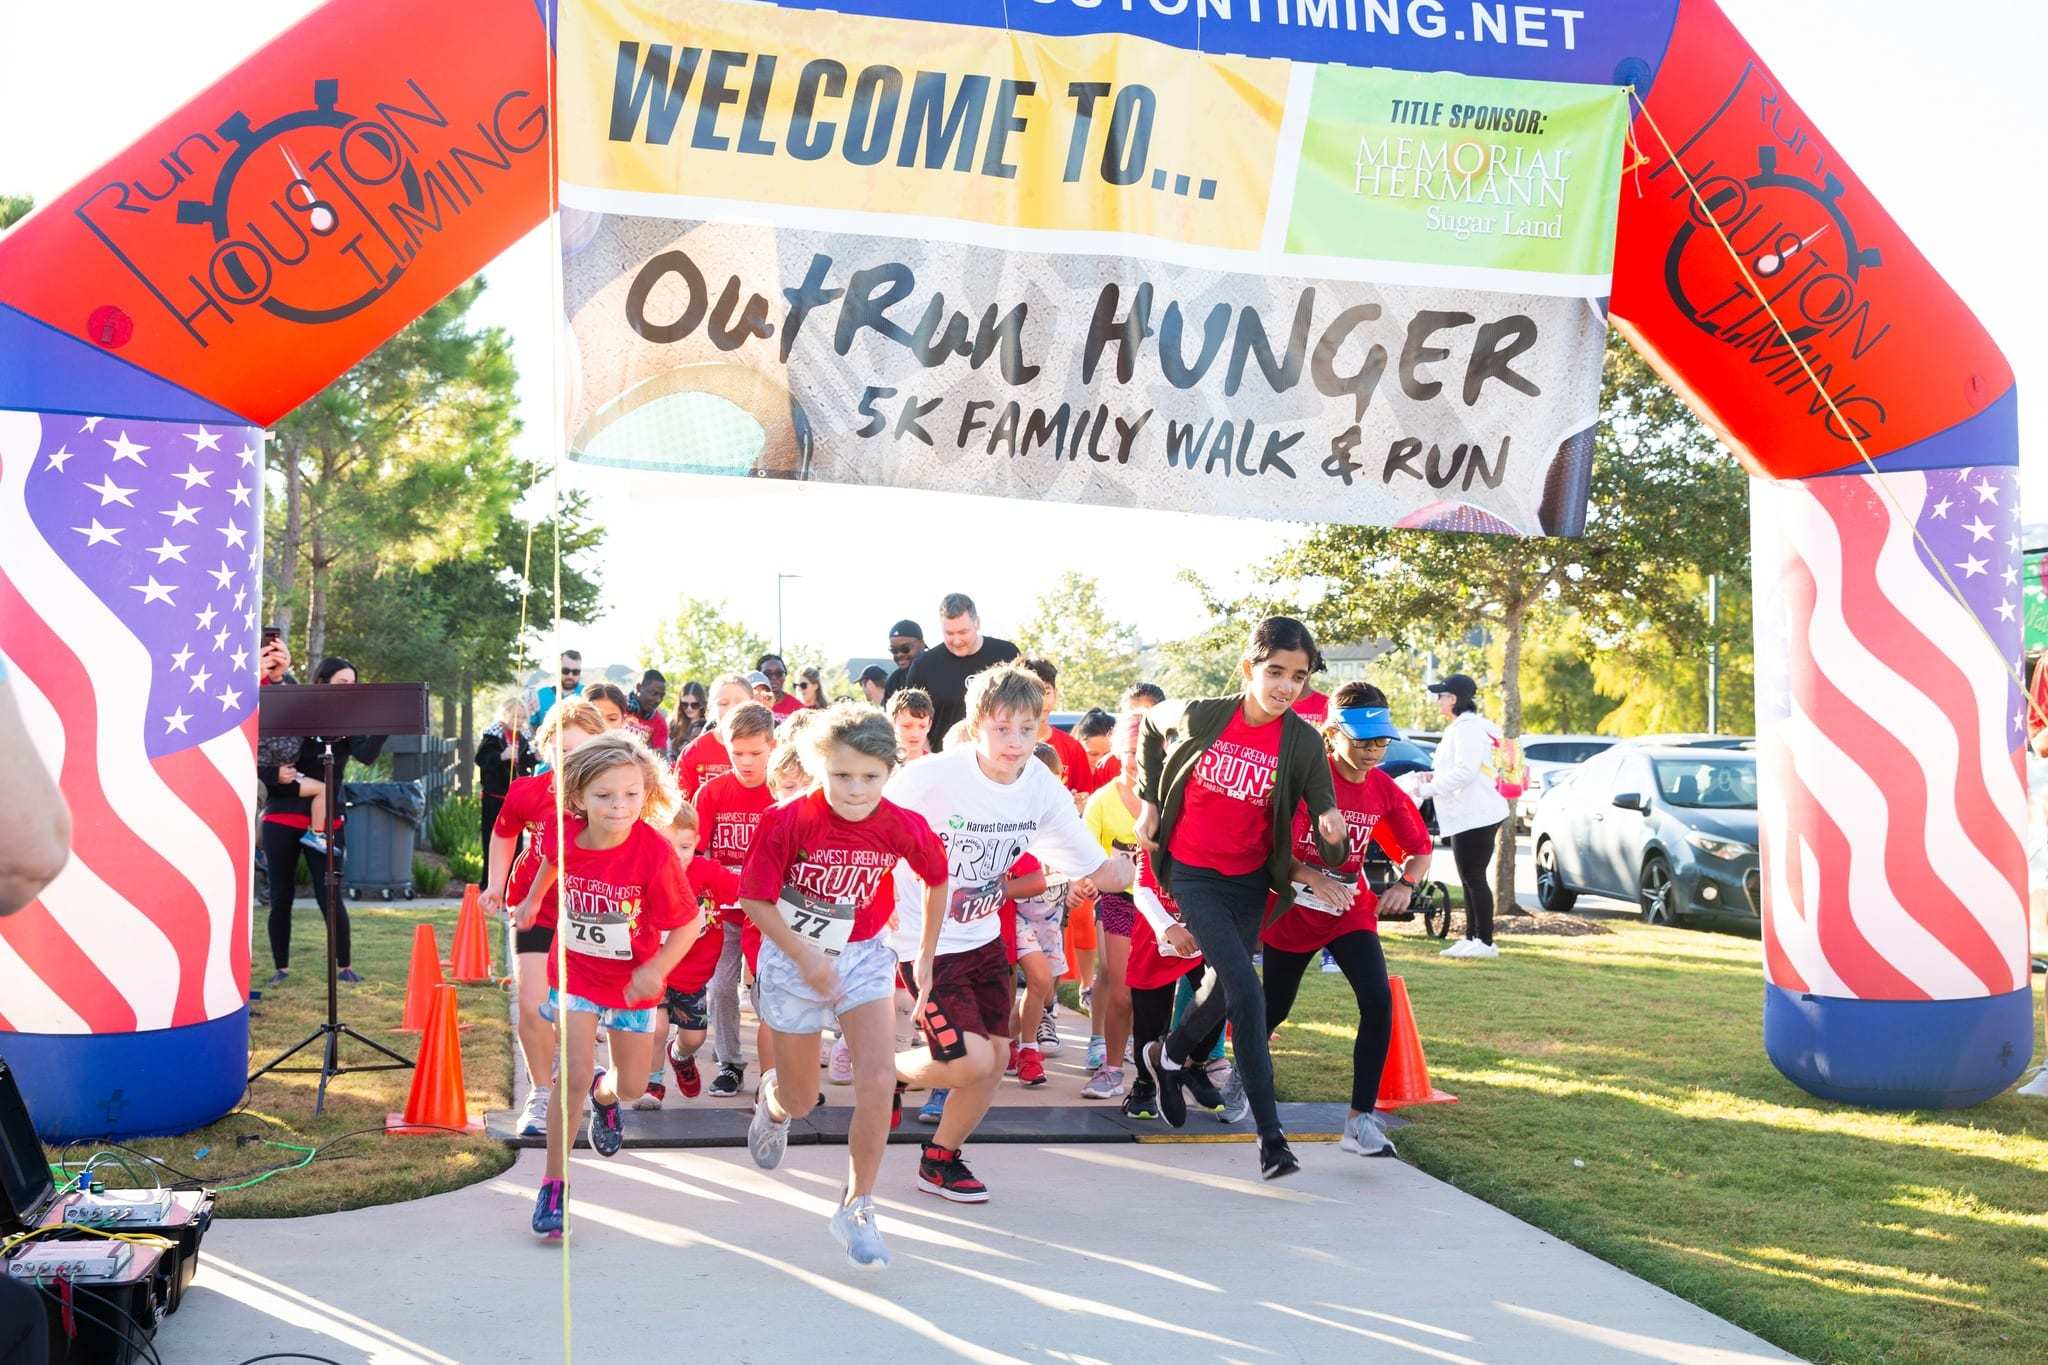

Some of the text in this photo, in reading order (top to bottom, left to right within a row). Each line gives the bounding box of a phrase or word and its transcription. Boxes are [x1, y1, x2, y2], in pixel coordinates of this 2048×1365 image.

[608, 41, 1218, 200] WELCOME TO...
[1391, 99, 1548, 135] TITLE SPONSOR:
[75, 131, 219, 215] Run
[1354, 135, 1570, 180] MEMORIAL
[340, 90, 548, 288] TIMING
[1352, 162, 1569, 209] HERMANN
[164, 79, 448, 347] HOUSTON
[1426, 205, 1562, 241] Sugar Land
[1648, 155, 1890, 360] HOUSTON
[1083, 282, 1541, 423] HUNGER
[1700, 281, 1887, 442] TIMING
[856, 385, 1511, 492] 5K FAMILY WALK & RUN
[1196, 748, 1270, 798] RUN
[966, 819, 1037, 832] Harvest Green Hosts
[797, 862, 883, 900] RUN
[851, 850, 879, 866] GREEN
[587, 879, 613, 898] GREEN
[614, 885, 642, 900] HOSTS
[572, 923, 606, 944] 76
[791, 911, 831, 939] 77
